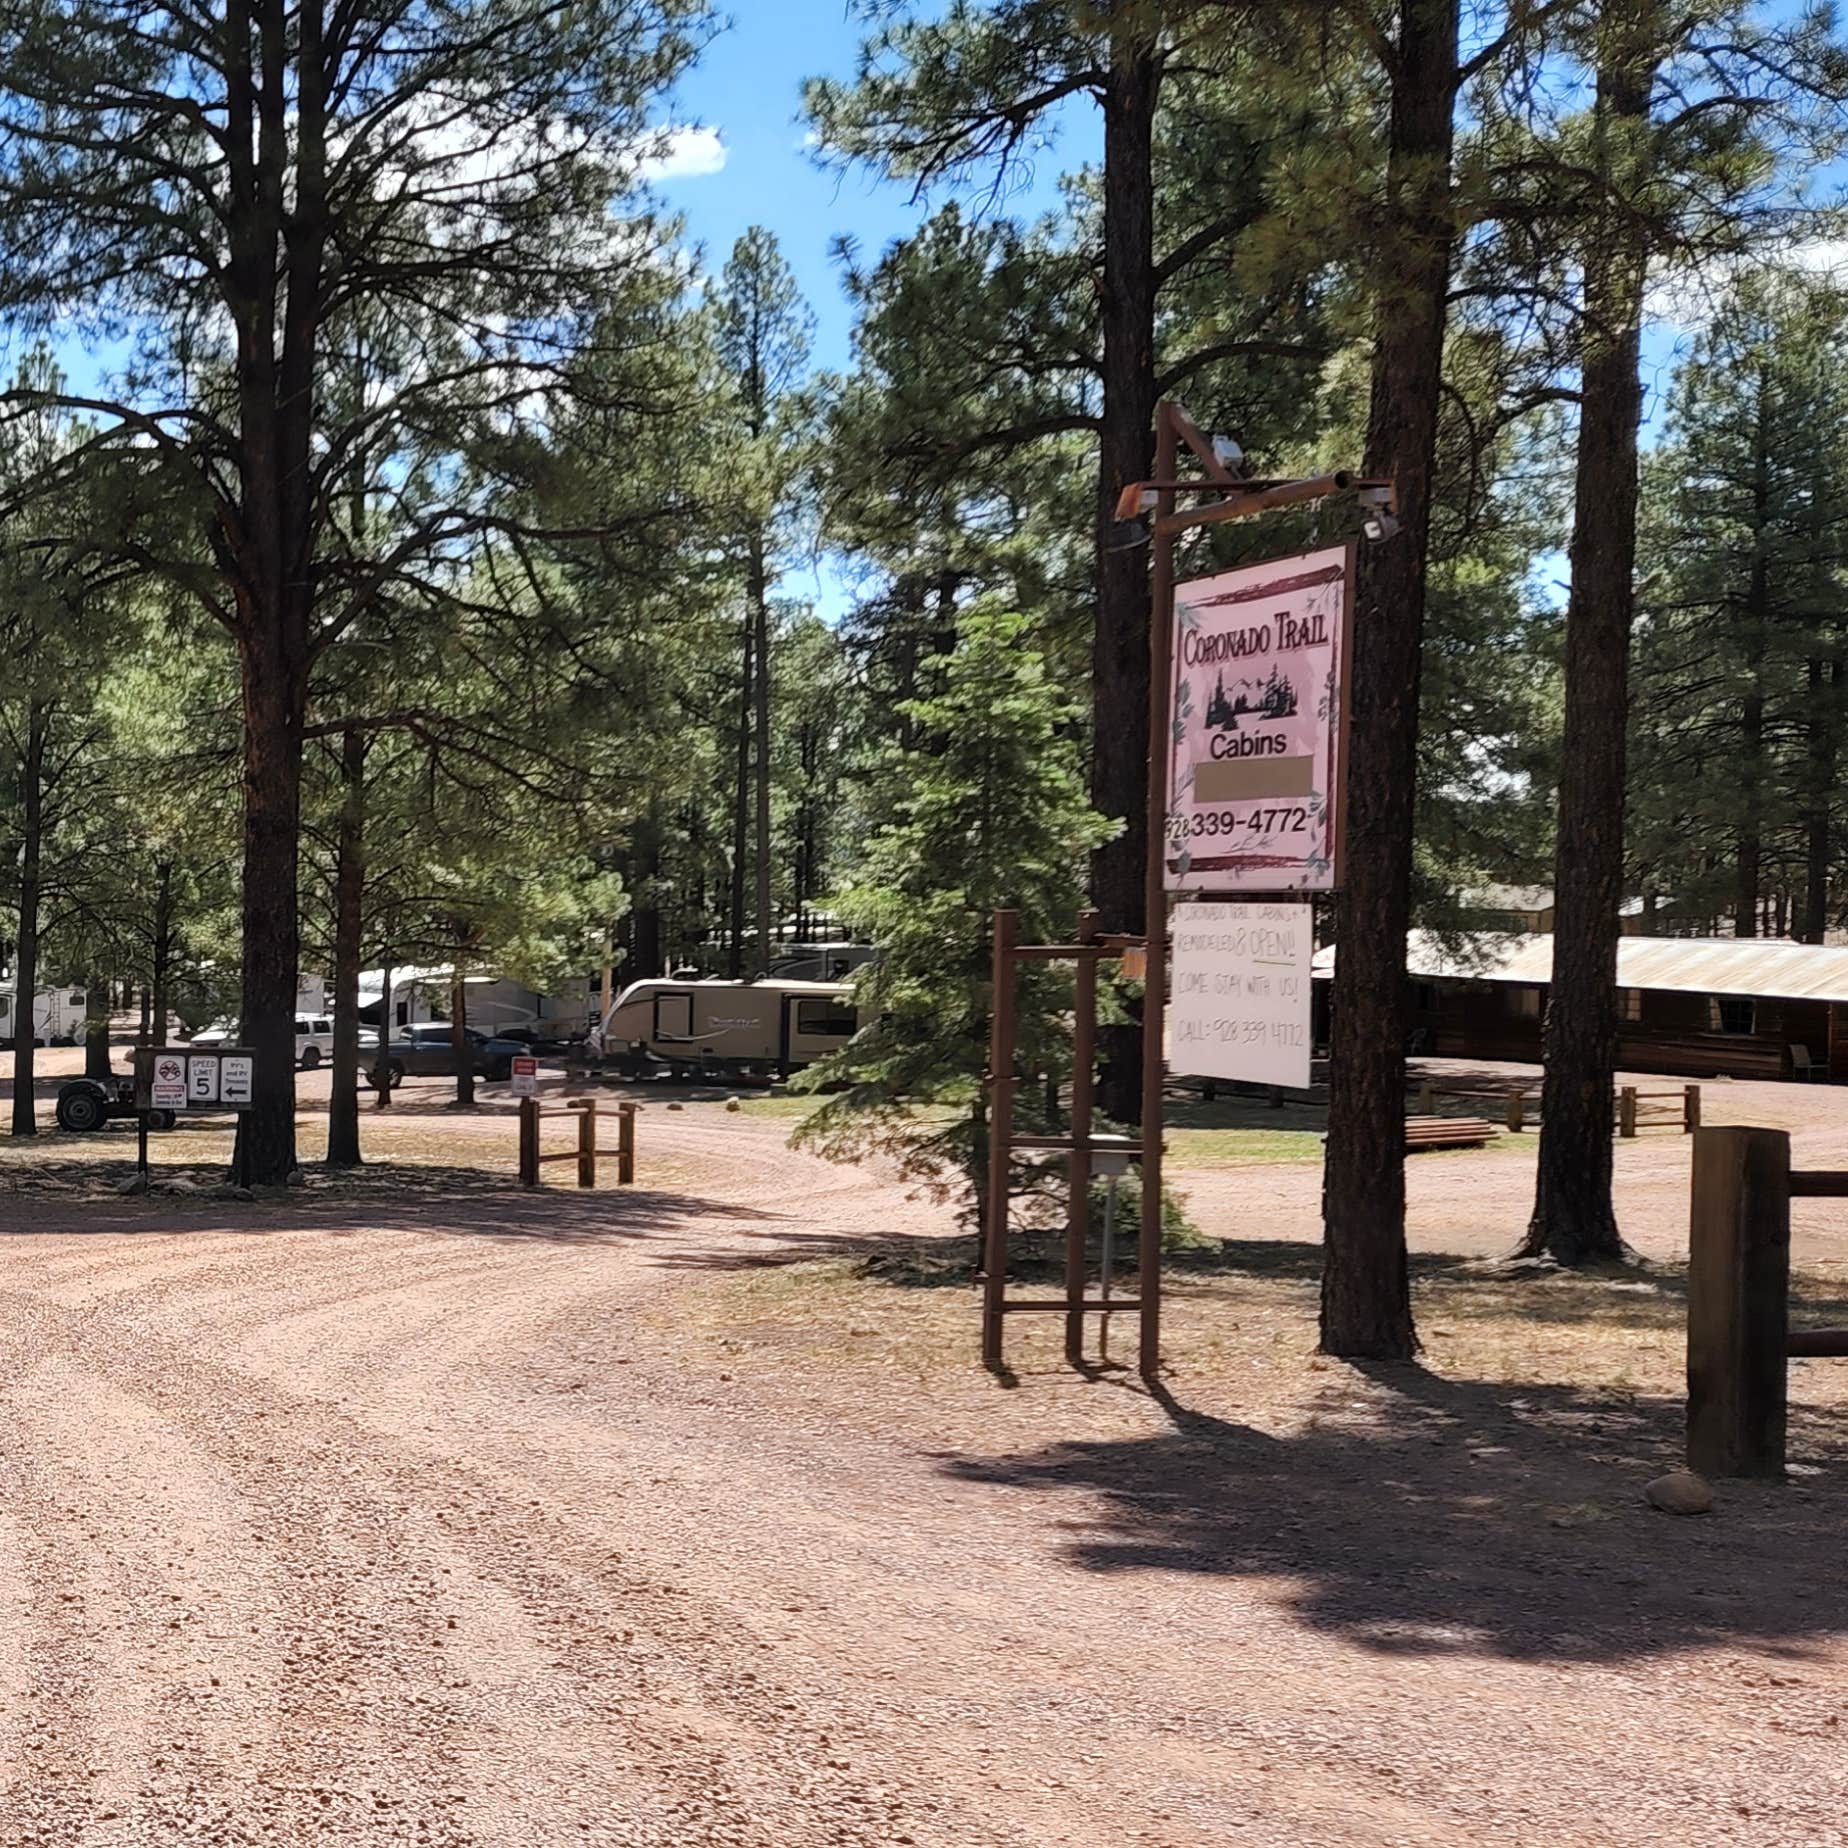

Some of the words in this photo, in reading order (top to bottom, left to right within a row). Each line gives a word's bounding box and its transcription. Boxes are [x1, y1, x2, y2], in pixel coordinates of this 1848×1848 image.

[1274, 611, 1328, 651] TRAIL
[1210, 729, 1287, 759] Cabins
[1191, 807, 1307, 836] 339-4772
[1177, 971, 1209, 994] COME
[1215, 972, 1241, 996] STAY
[1280, 976, 1299, 1003] US!
[1271, 1022, 1304, 1047] 4772
[196, 1078, 210, 1095] 5
